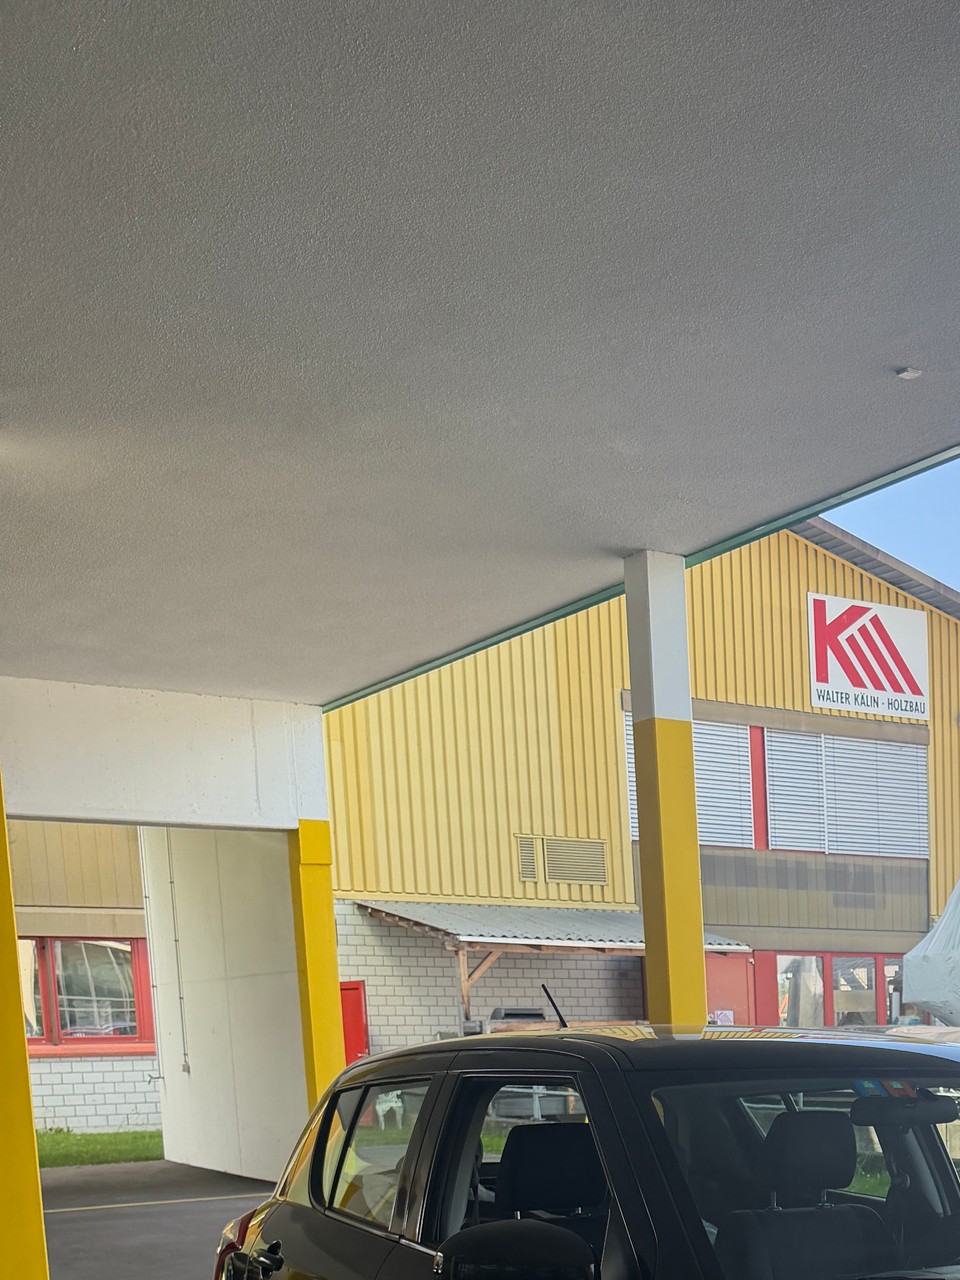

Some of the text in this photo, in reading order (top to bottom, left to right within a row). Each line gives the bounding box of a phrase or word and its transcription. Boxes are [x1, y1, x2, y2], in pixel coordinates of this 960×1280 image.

[816, 688, 851, 705] WALTER
[854, 692, 879, 708] KÄLIN
[887, 697, 926, 714] HOLZBAU
